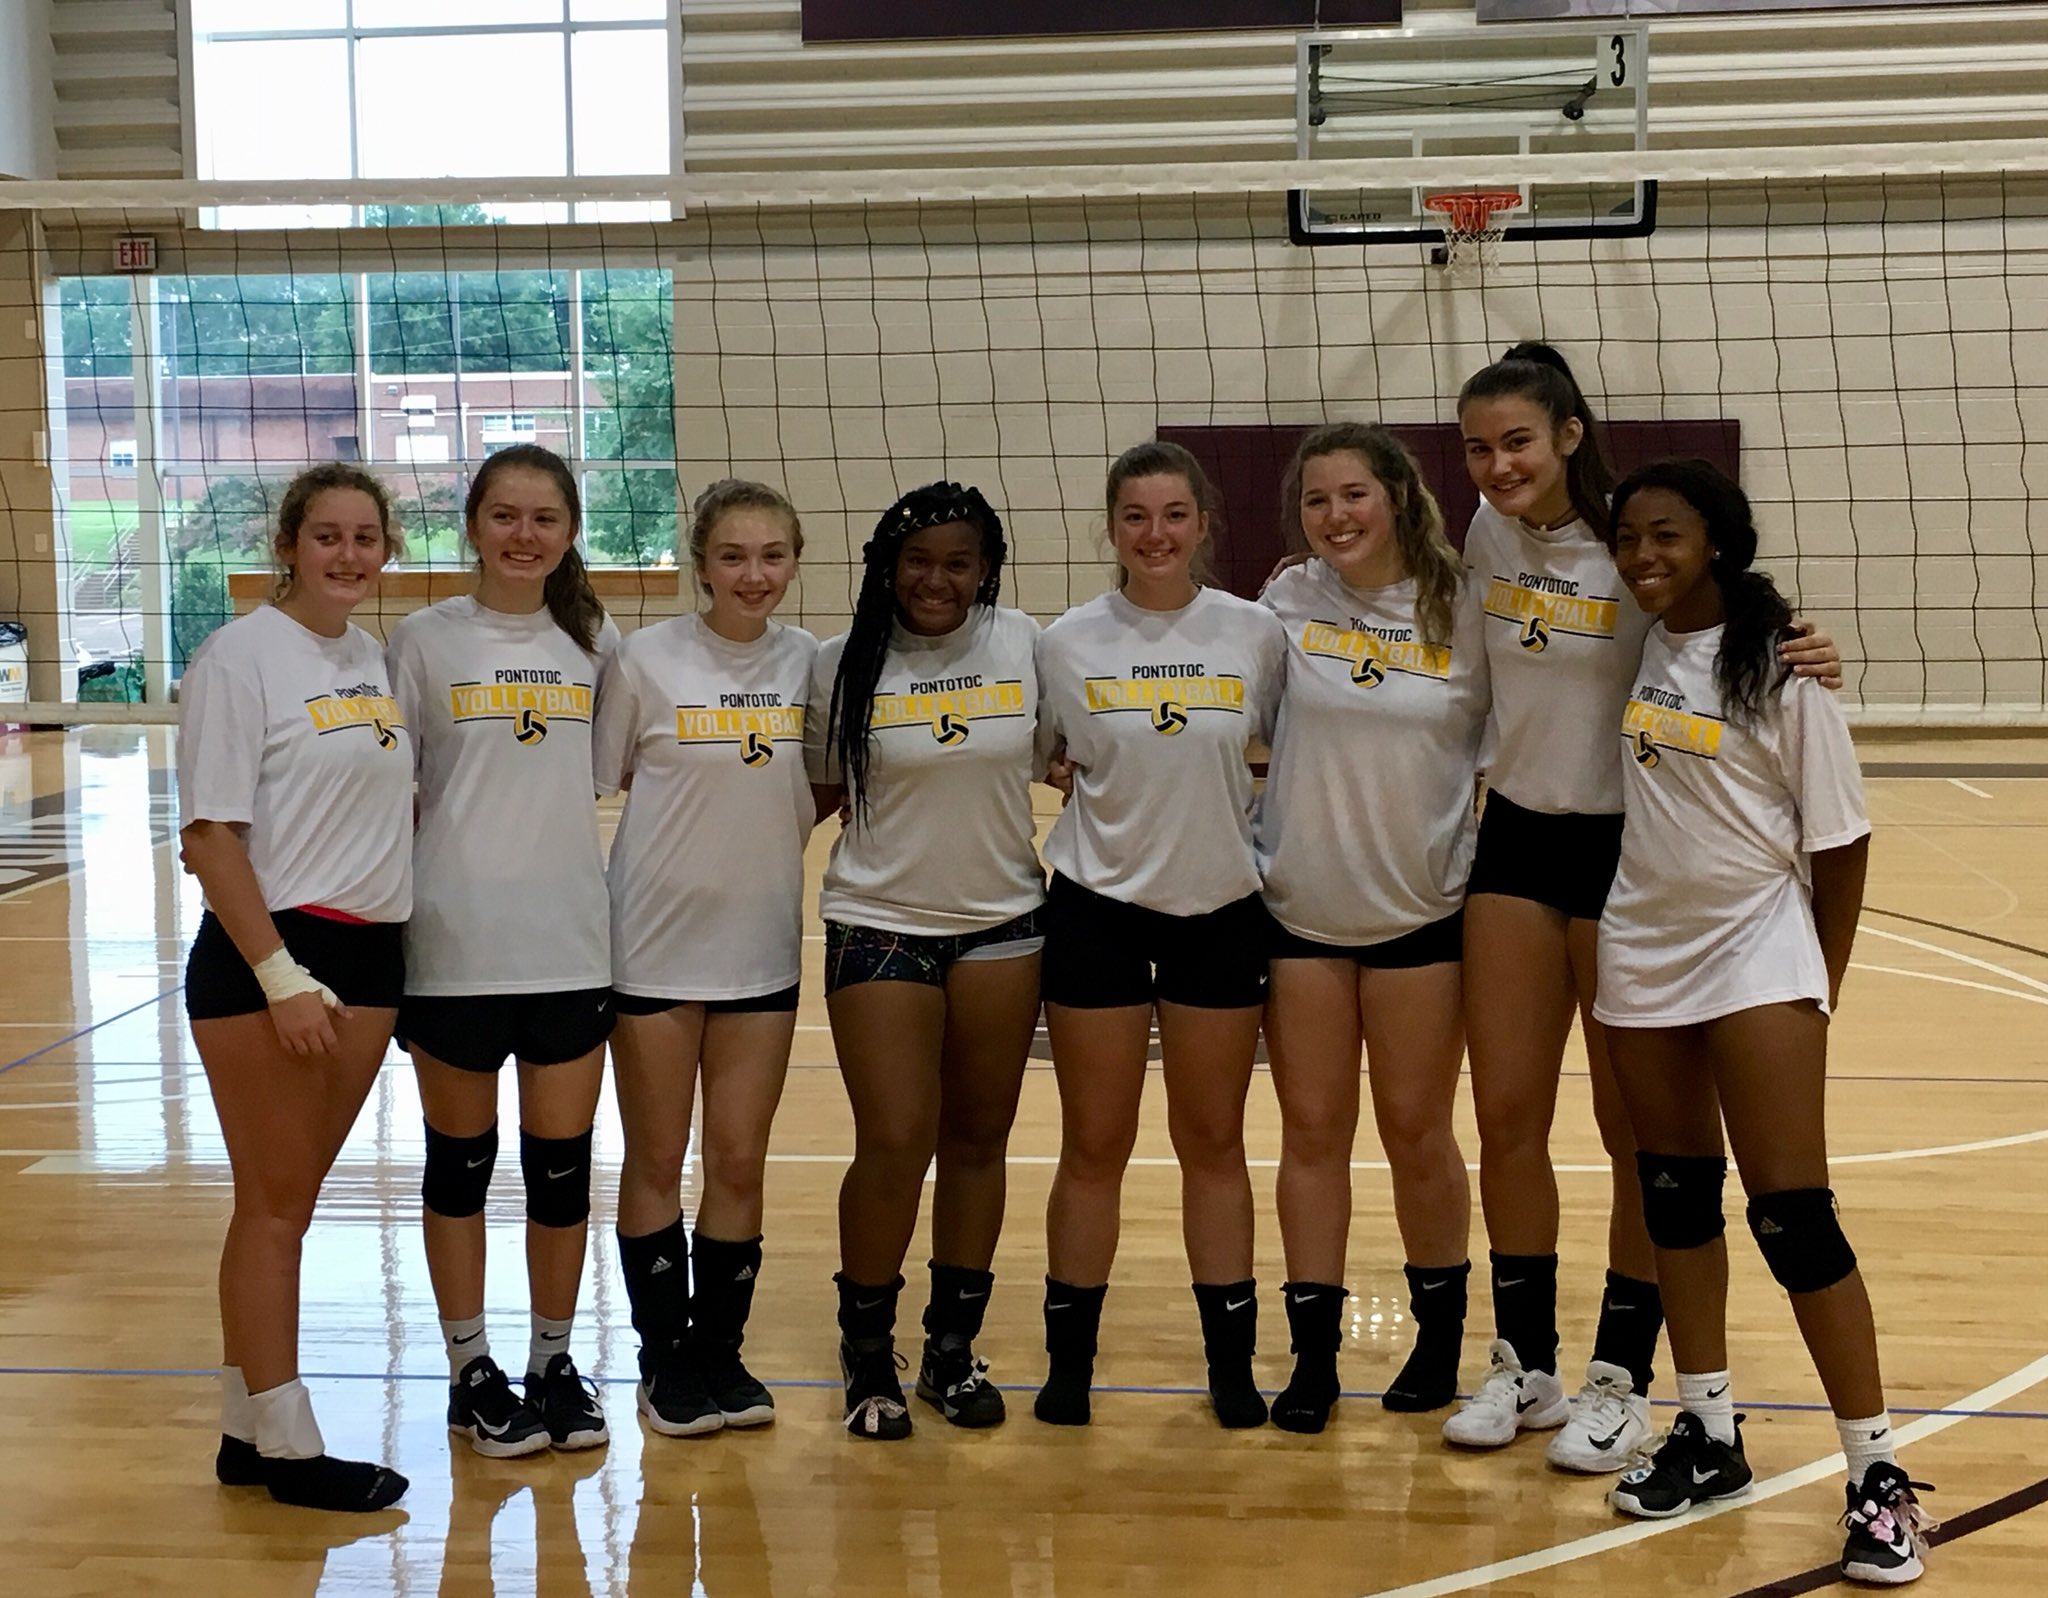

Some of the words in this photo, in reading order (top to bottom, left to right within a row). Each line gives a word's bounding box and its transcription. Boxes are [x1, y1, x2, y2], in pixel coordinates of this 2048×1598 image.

[1610, 35, 1626, 87] 3
[120, 241, 150, 266] EXIT
[1518, 572, 1580, 597] PONTOTOC
[1491, 586, 1611, 632] OLLEYBALL
[1308, 625, 1447, 675] VOLLEYBAL
[494, 669, 562, 684] PONTOTOC
[1131, 663, 1205, 679] PONTOTOC
[910, 674, 983, 695] PONTOTOC
[1093, 681, 1241, 706] VOLLEYBALL
[456, 687, 589, 715] VOLLEYBALL
[720, 693, 783, 708] PONTOTOC
[1637, 685, 1686, 711] PONTOTOC
[682, 710, 801, 735] VOLLEYBAL
